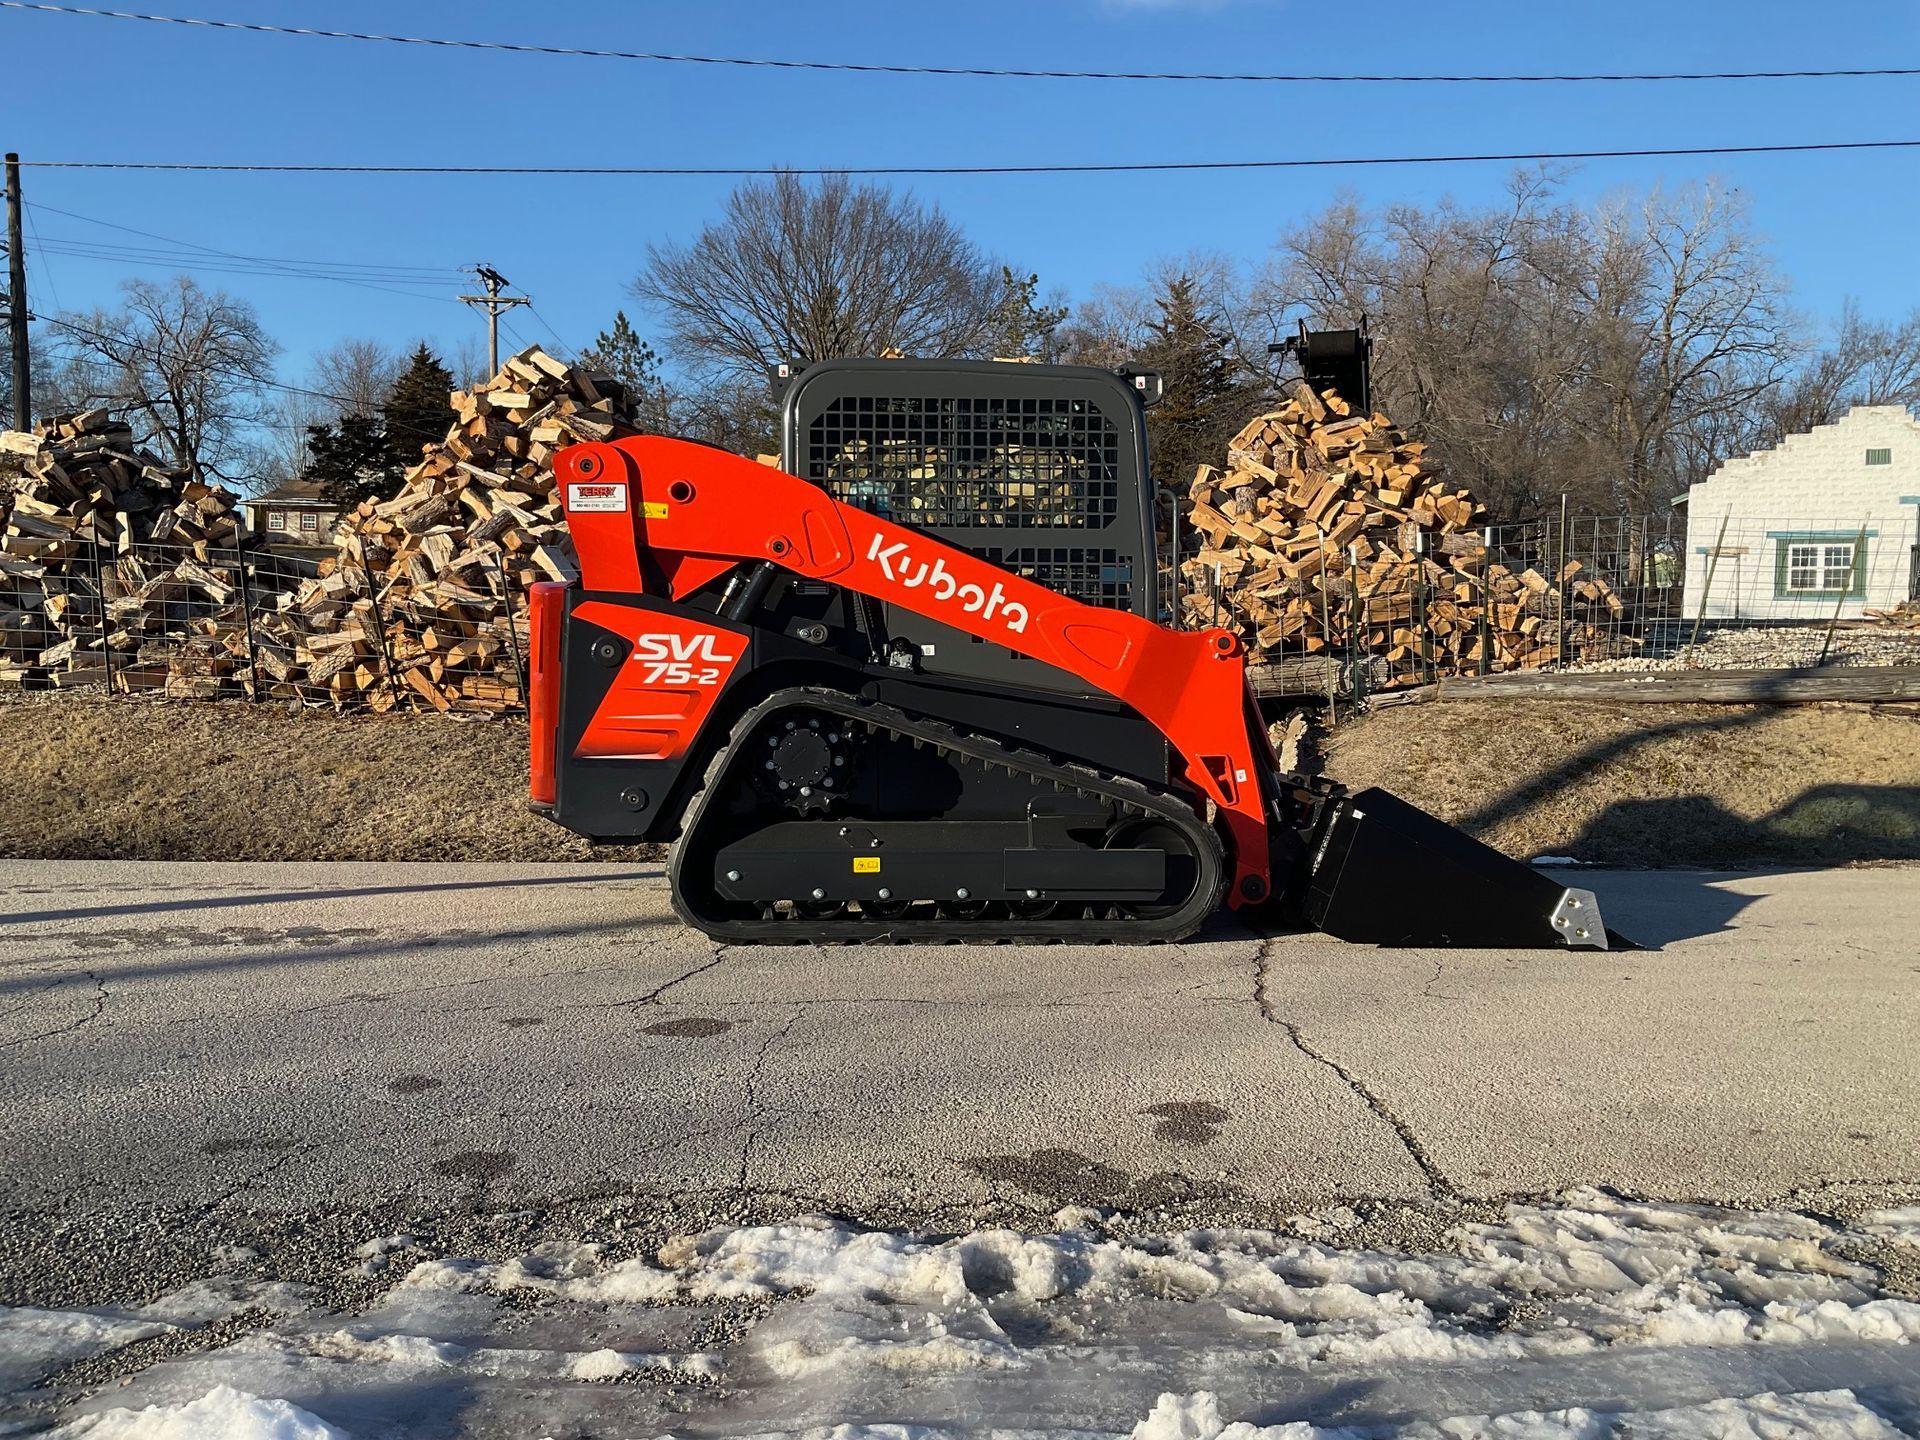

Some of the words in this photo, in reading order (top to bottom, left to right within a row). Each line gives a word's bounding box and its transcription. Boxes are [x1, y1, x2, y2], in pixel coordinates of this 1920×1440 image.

[577, 486, 617, 497] TERRY
[867, 532, 1029, 634] Kubota
[633, 633, 733, 662] SVL
[643, 662, 720, 685] 75-2
